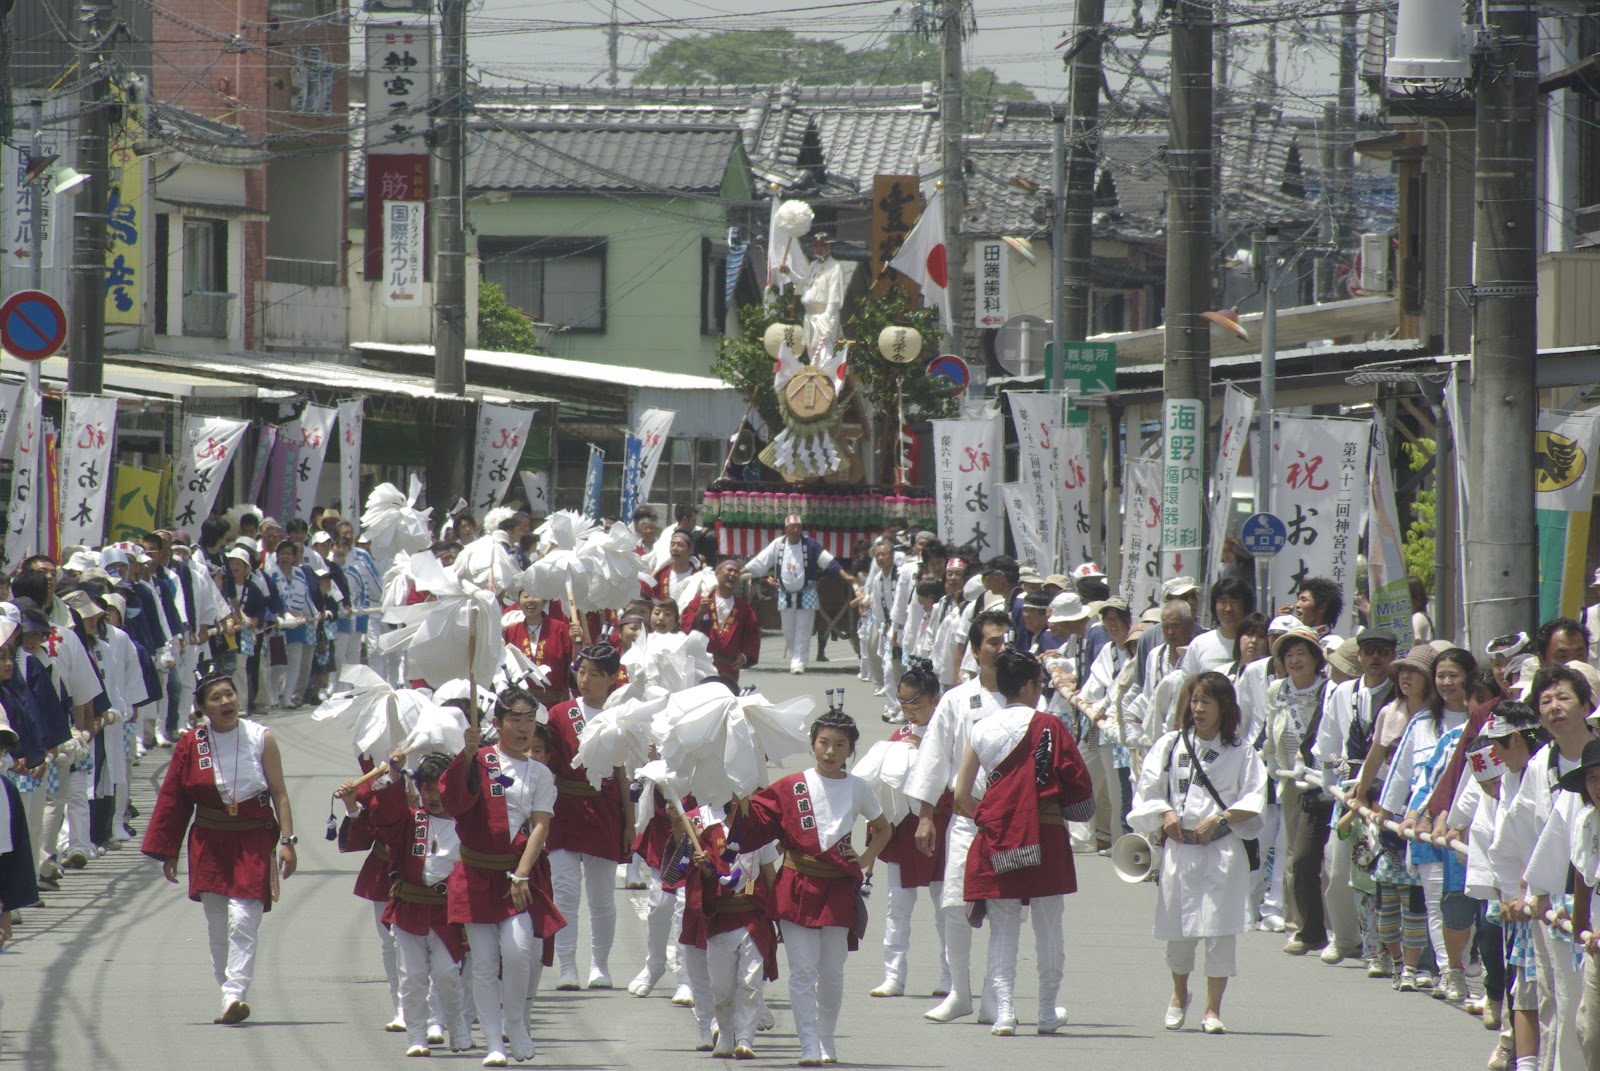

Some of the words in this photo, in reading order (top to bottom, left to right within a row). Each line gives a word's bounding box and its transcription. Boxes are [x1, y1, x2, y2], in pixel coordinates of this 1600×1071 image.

[984, 245, 1000, 313] 田端歯科
[1064, 362, 1097, 371] Refuge
[1065, 349, 1108, 362] 難場所
[1170, 405, 1196, 461] 海野
[1163, 466, 1180, 547] 循環器科
